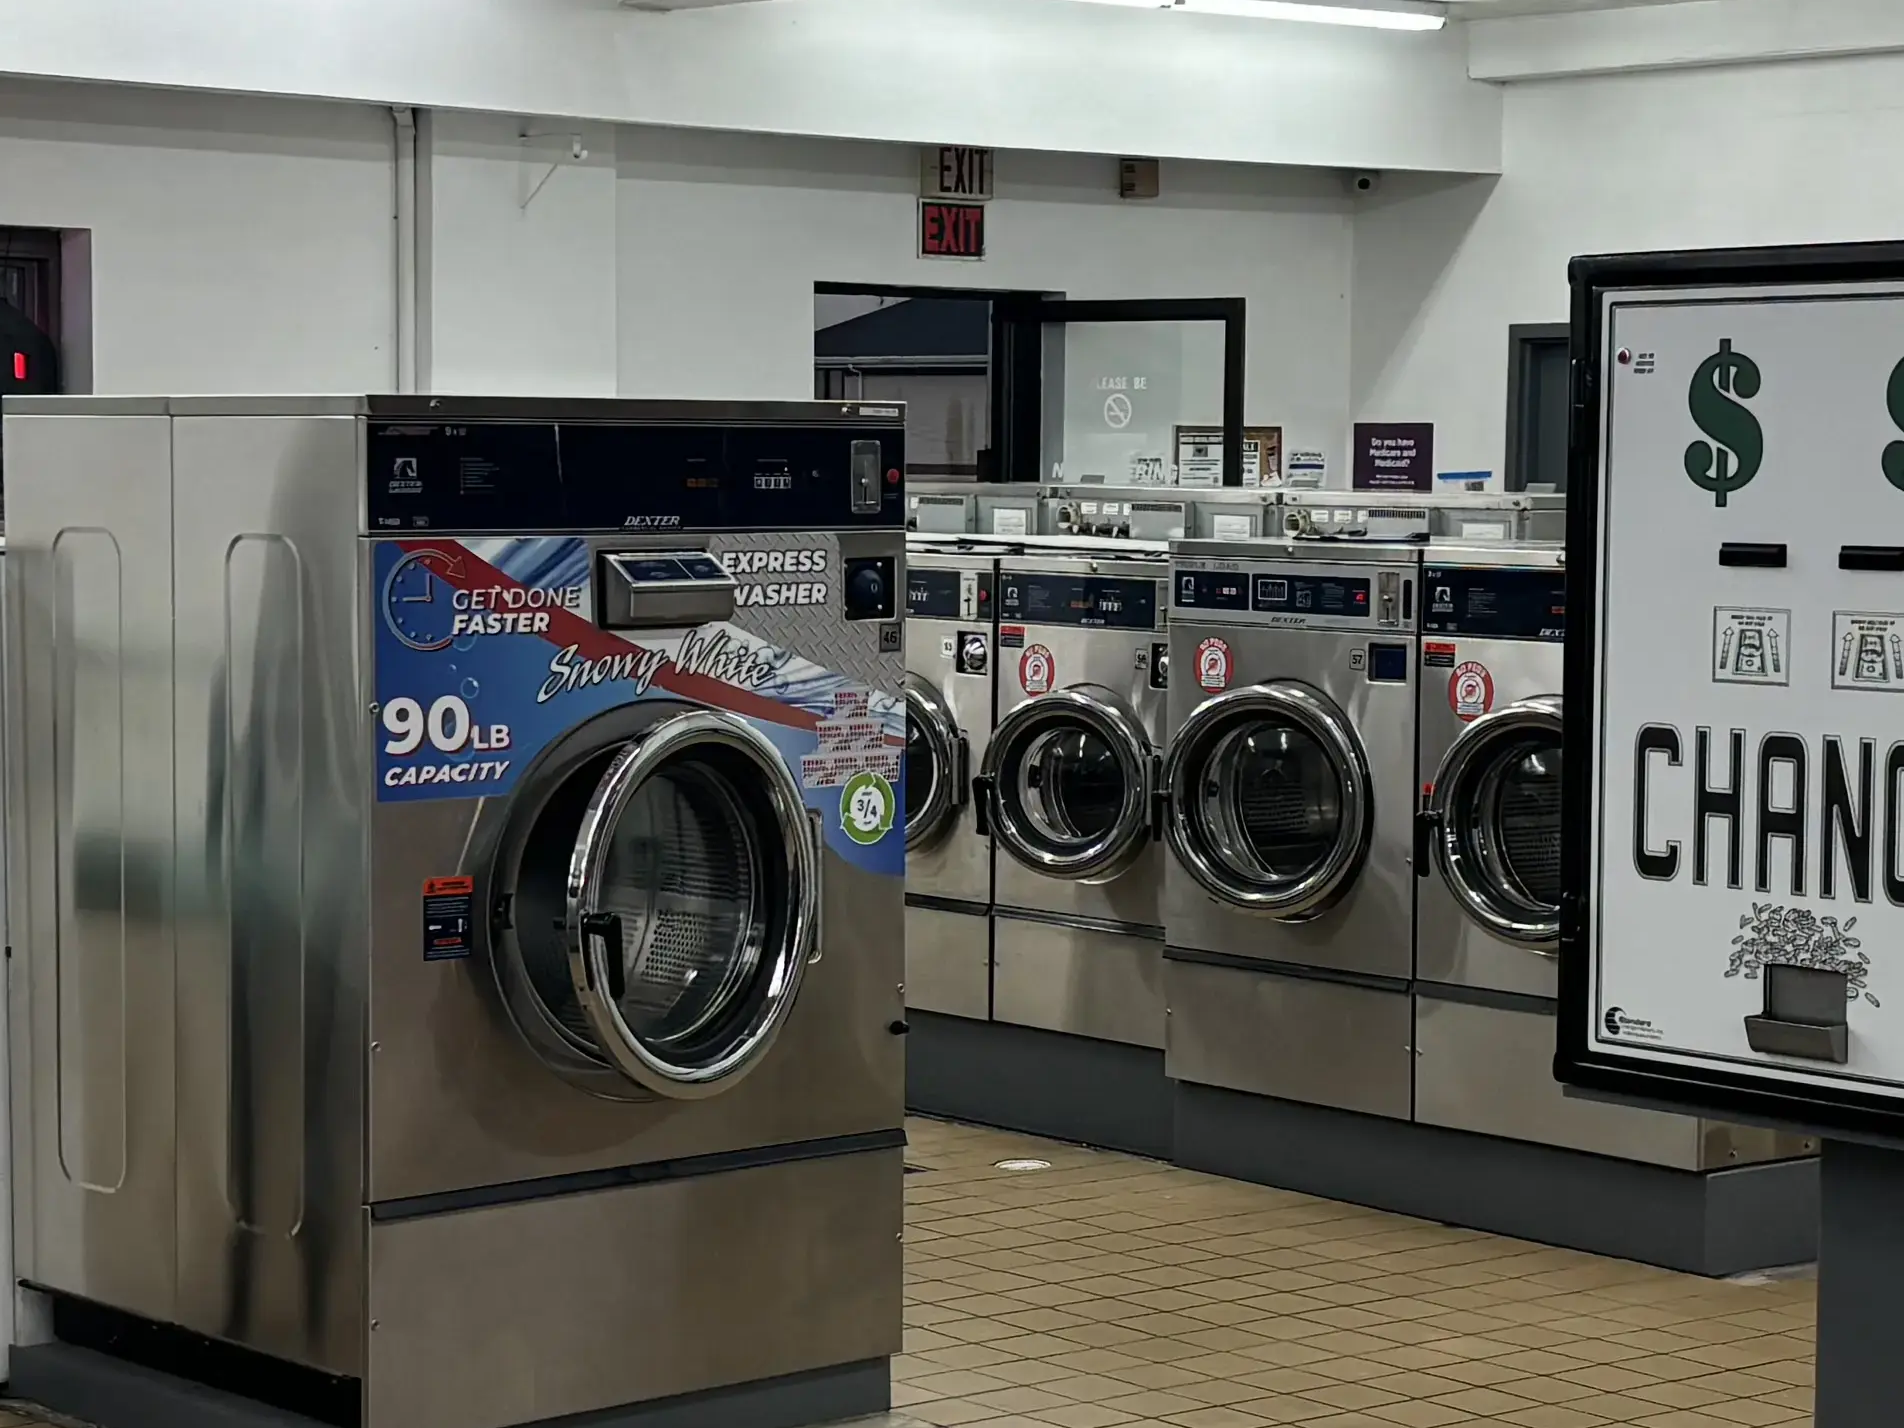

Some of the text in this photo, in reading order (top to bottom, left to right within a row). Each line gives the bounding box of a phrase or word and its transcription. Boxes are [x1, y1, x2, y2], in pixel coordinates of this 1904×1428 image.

[939, 146, 988, 194] EXIT
[924, 205, 981, 253] EXIT
[624, 516, 681, 527] DEXTER
[723, 549, 827, 574] EXPRESS
[452, 586, 581, 610] GET DONE
[452, 612, 550, 635] FASTER
[536, 628, 777, 703] Snowy White
[384, 760, 510, 786] CAPACITY
